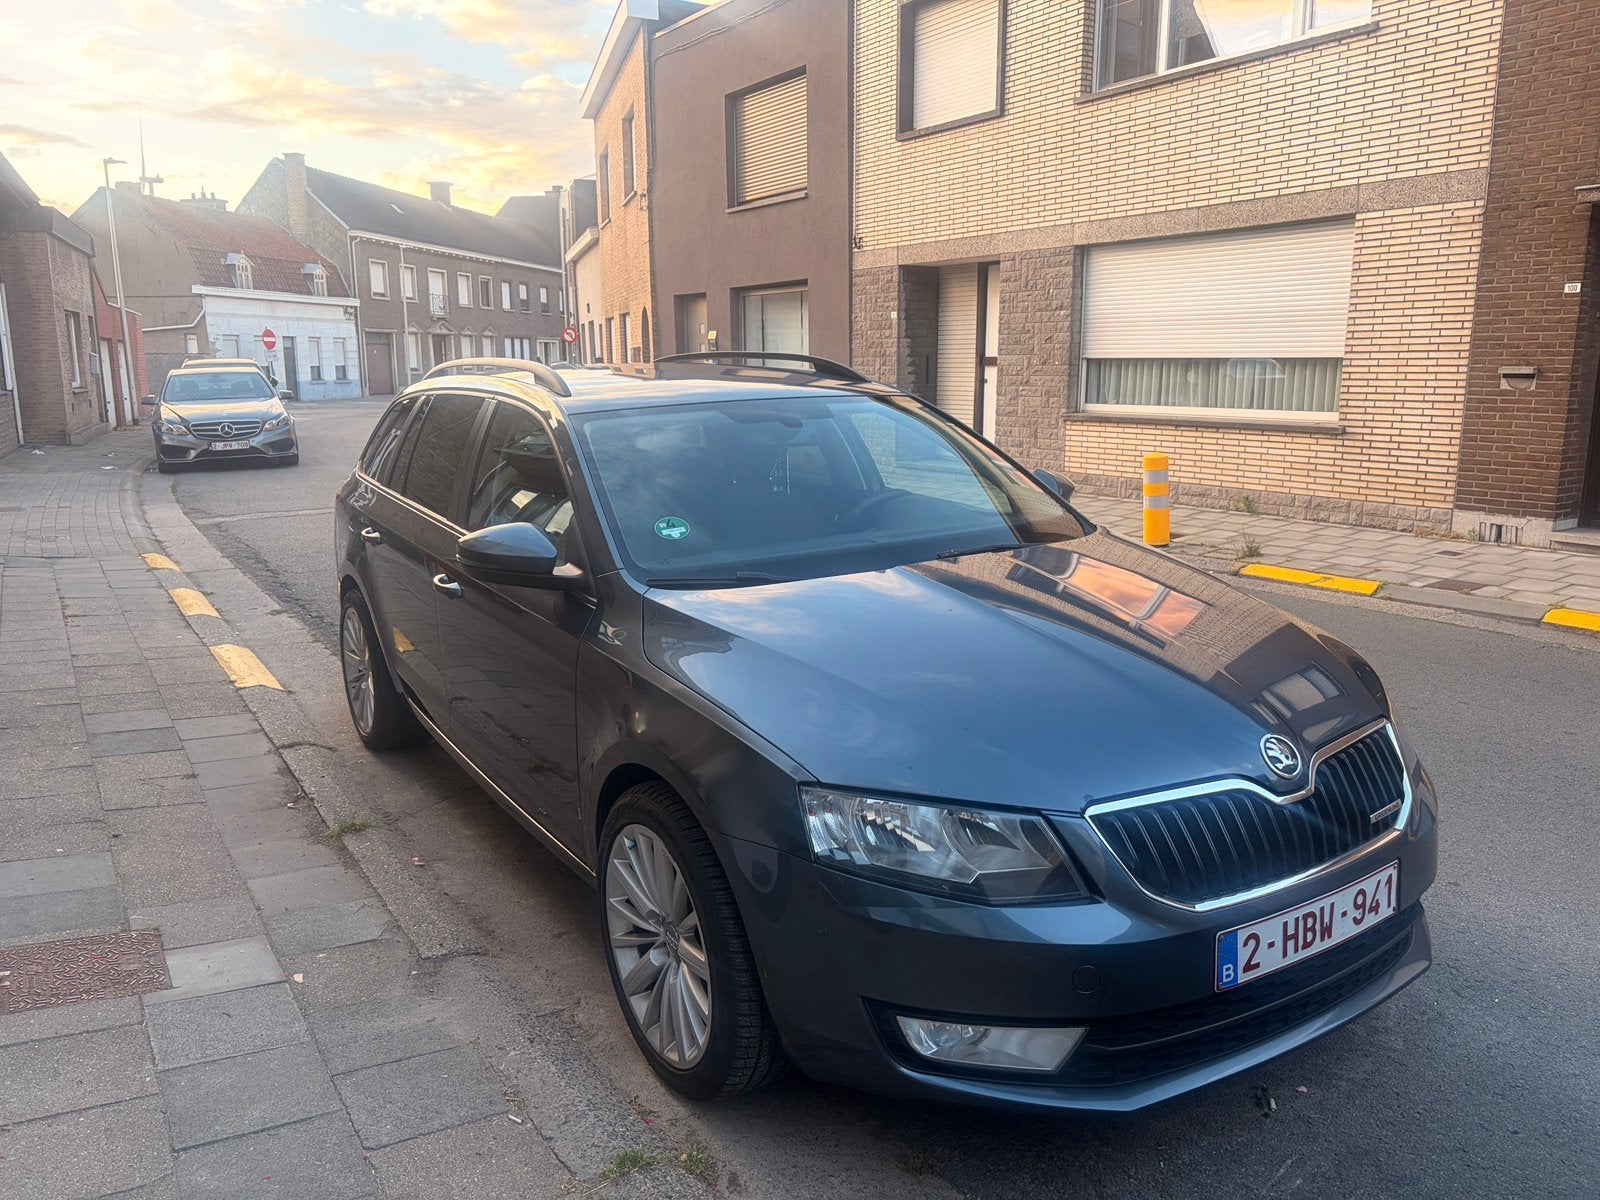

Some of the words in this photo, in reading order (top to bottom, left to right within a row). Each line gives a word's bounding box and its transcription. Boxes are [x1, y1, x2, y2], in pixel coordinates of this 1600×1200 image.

[1567, 284, 1578, 292] 100
[1242, 872, 1393, 974] 2-HBW-941
[1222, 963, 1235, 983] B
